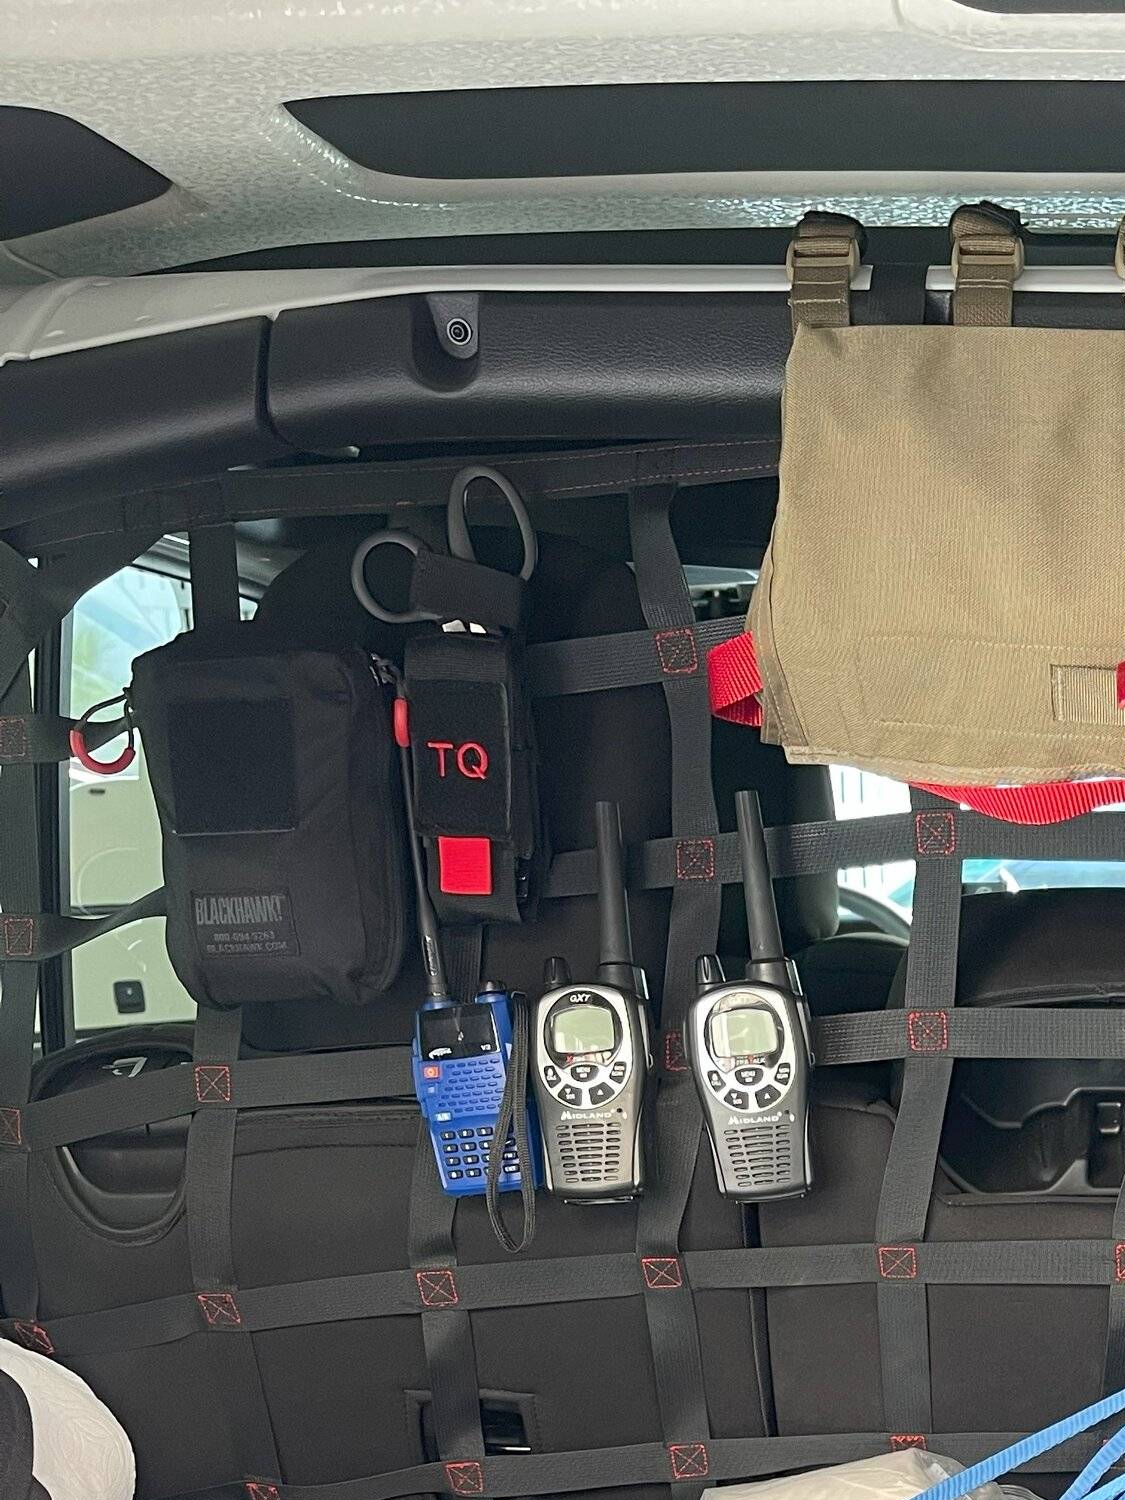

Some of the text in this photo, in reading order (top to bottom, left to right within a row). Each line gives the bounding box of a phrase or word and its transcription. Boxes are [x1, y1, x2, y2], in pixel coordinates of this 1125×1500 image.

[426, 741, 489, 780] TQ
[195, 895, 286, 925] BLACKHAWK!
[560, 1110, 613, 1121] MIDLAND
[727, 1114, 780, 1125] MIDLAND
